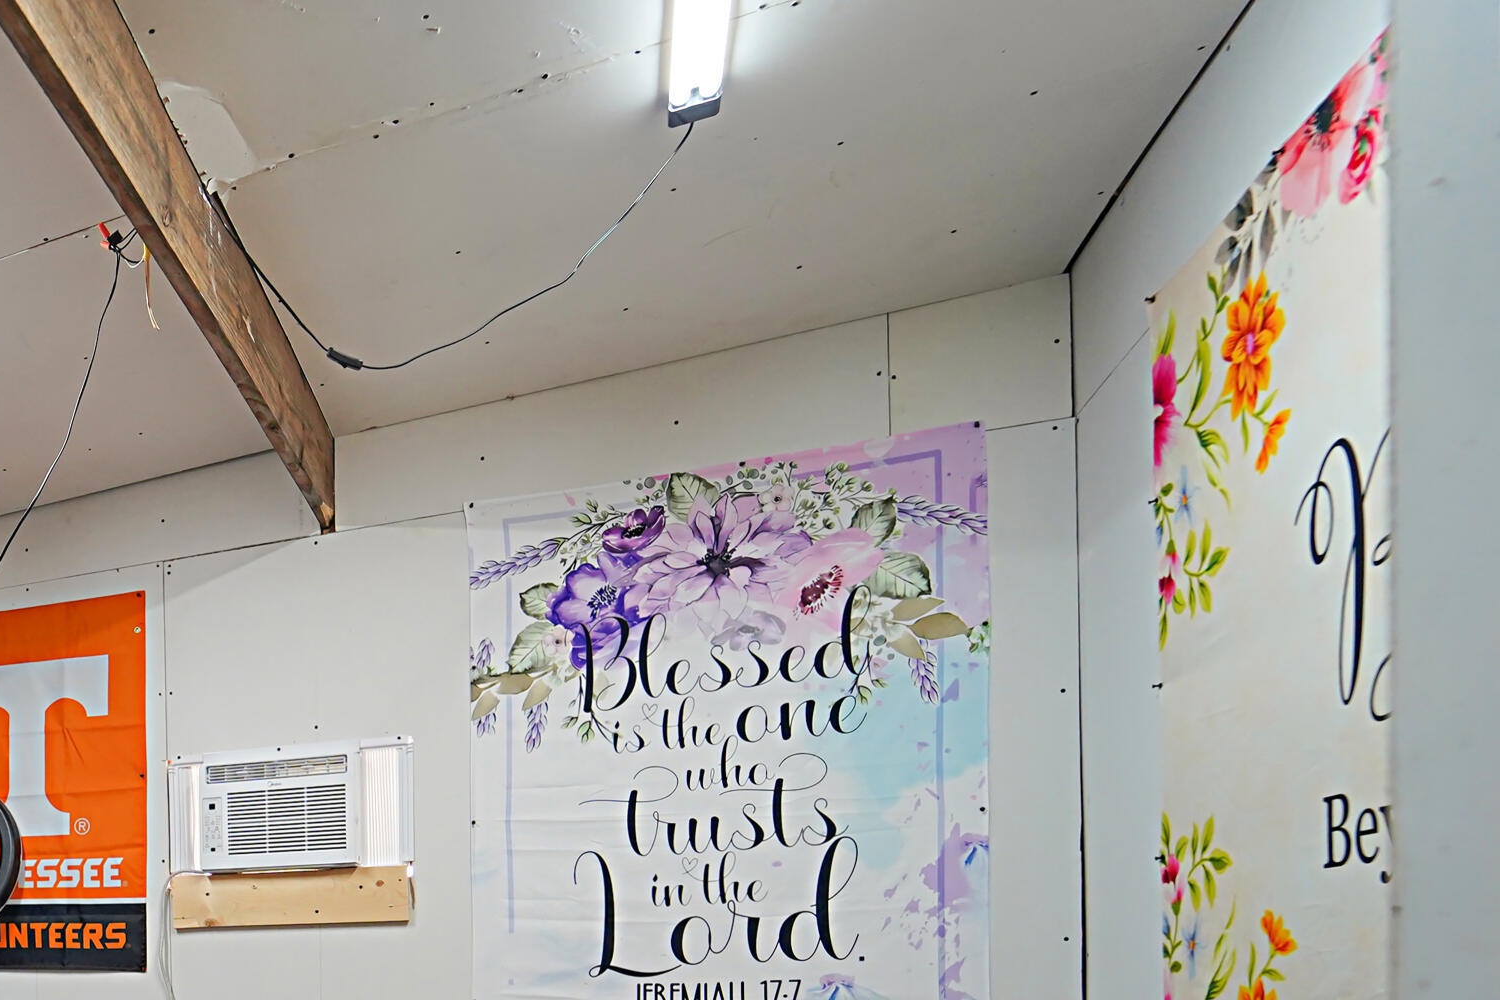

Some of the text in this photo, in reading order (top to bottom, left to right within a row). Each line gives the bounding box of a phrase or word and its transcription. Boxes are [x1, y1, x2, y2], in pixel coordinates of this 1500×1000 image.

[578, 585, 872, 716] Blessed
[612, 694, 867, 756] is the one
[681, 737, 779, 791] who
[579, 768, 849, 859] trusts
[573, 836, 867, 978] Lord.
[650, 856, 768, 907] in the
